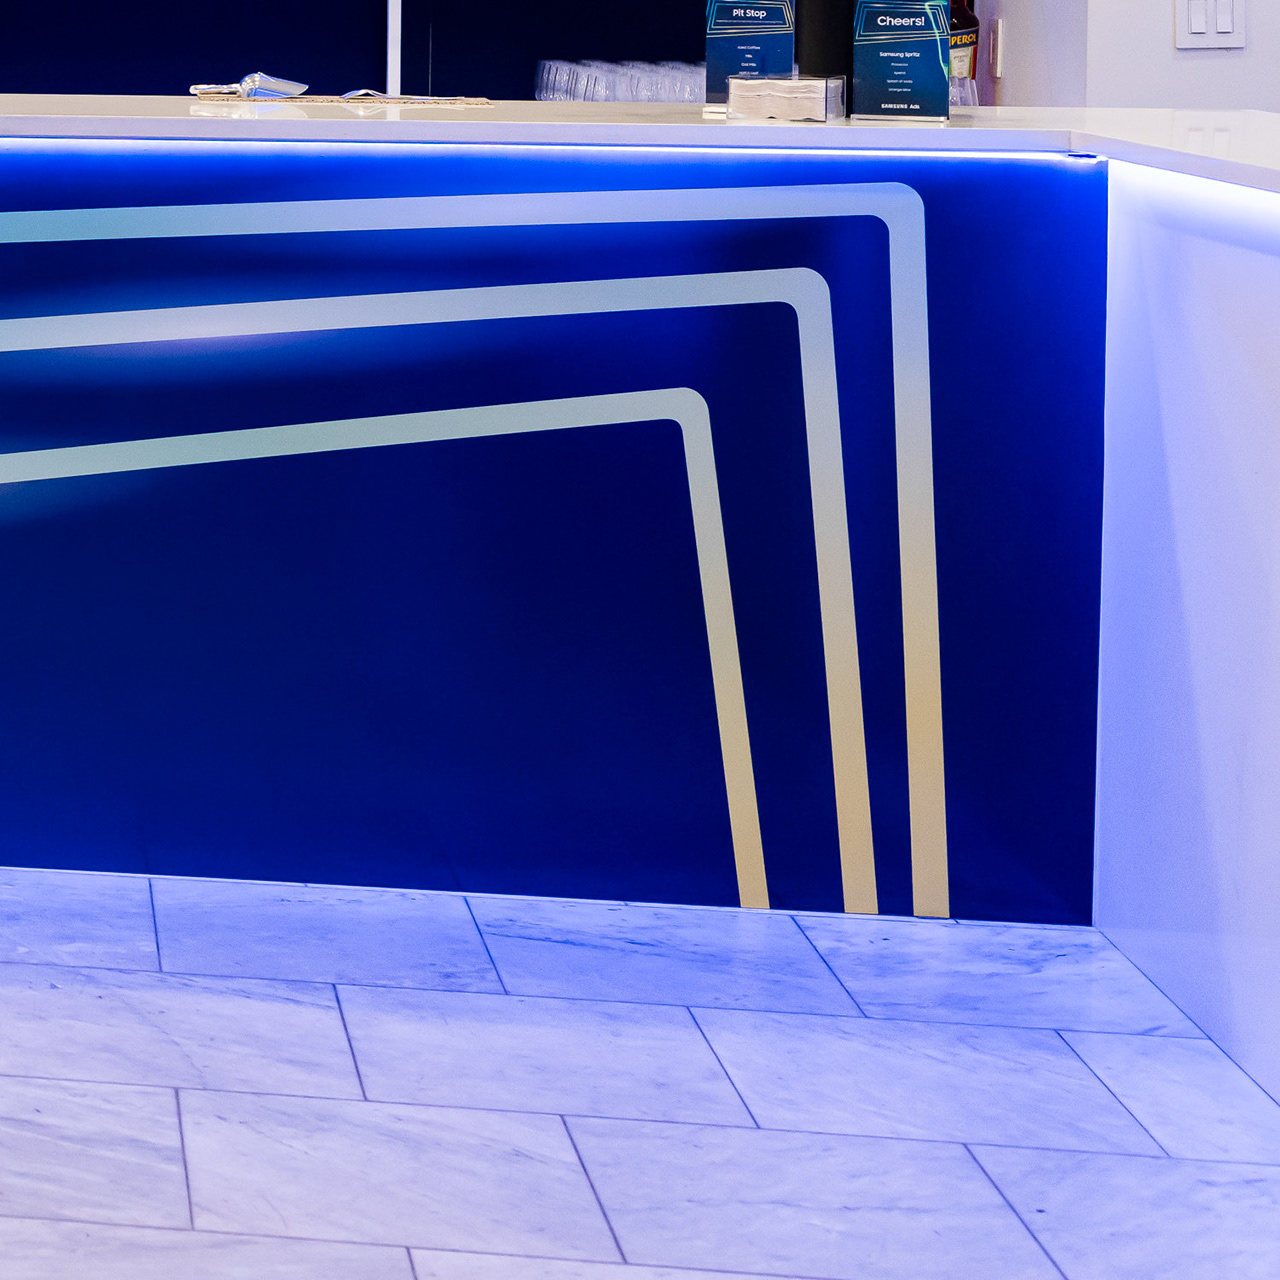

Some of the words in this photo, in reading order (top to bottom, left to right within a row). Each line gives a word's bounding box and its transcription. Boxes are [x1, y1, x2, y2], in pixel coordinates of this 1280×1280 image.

[732, 8, 744, 17] Pit
[745, 9, 767, 19] Stop
[877, 16, 925, 26] Cheers!
[949, 33, 977, 47] PEROL
